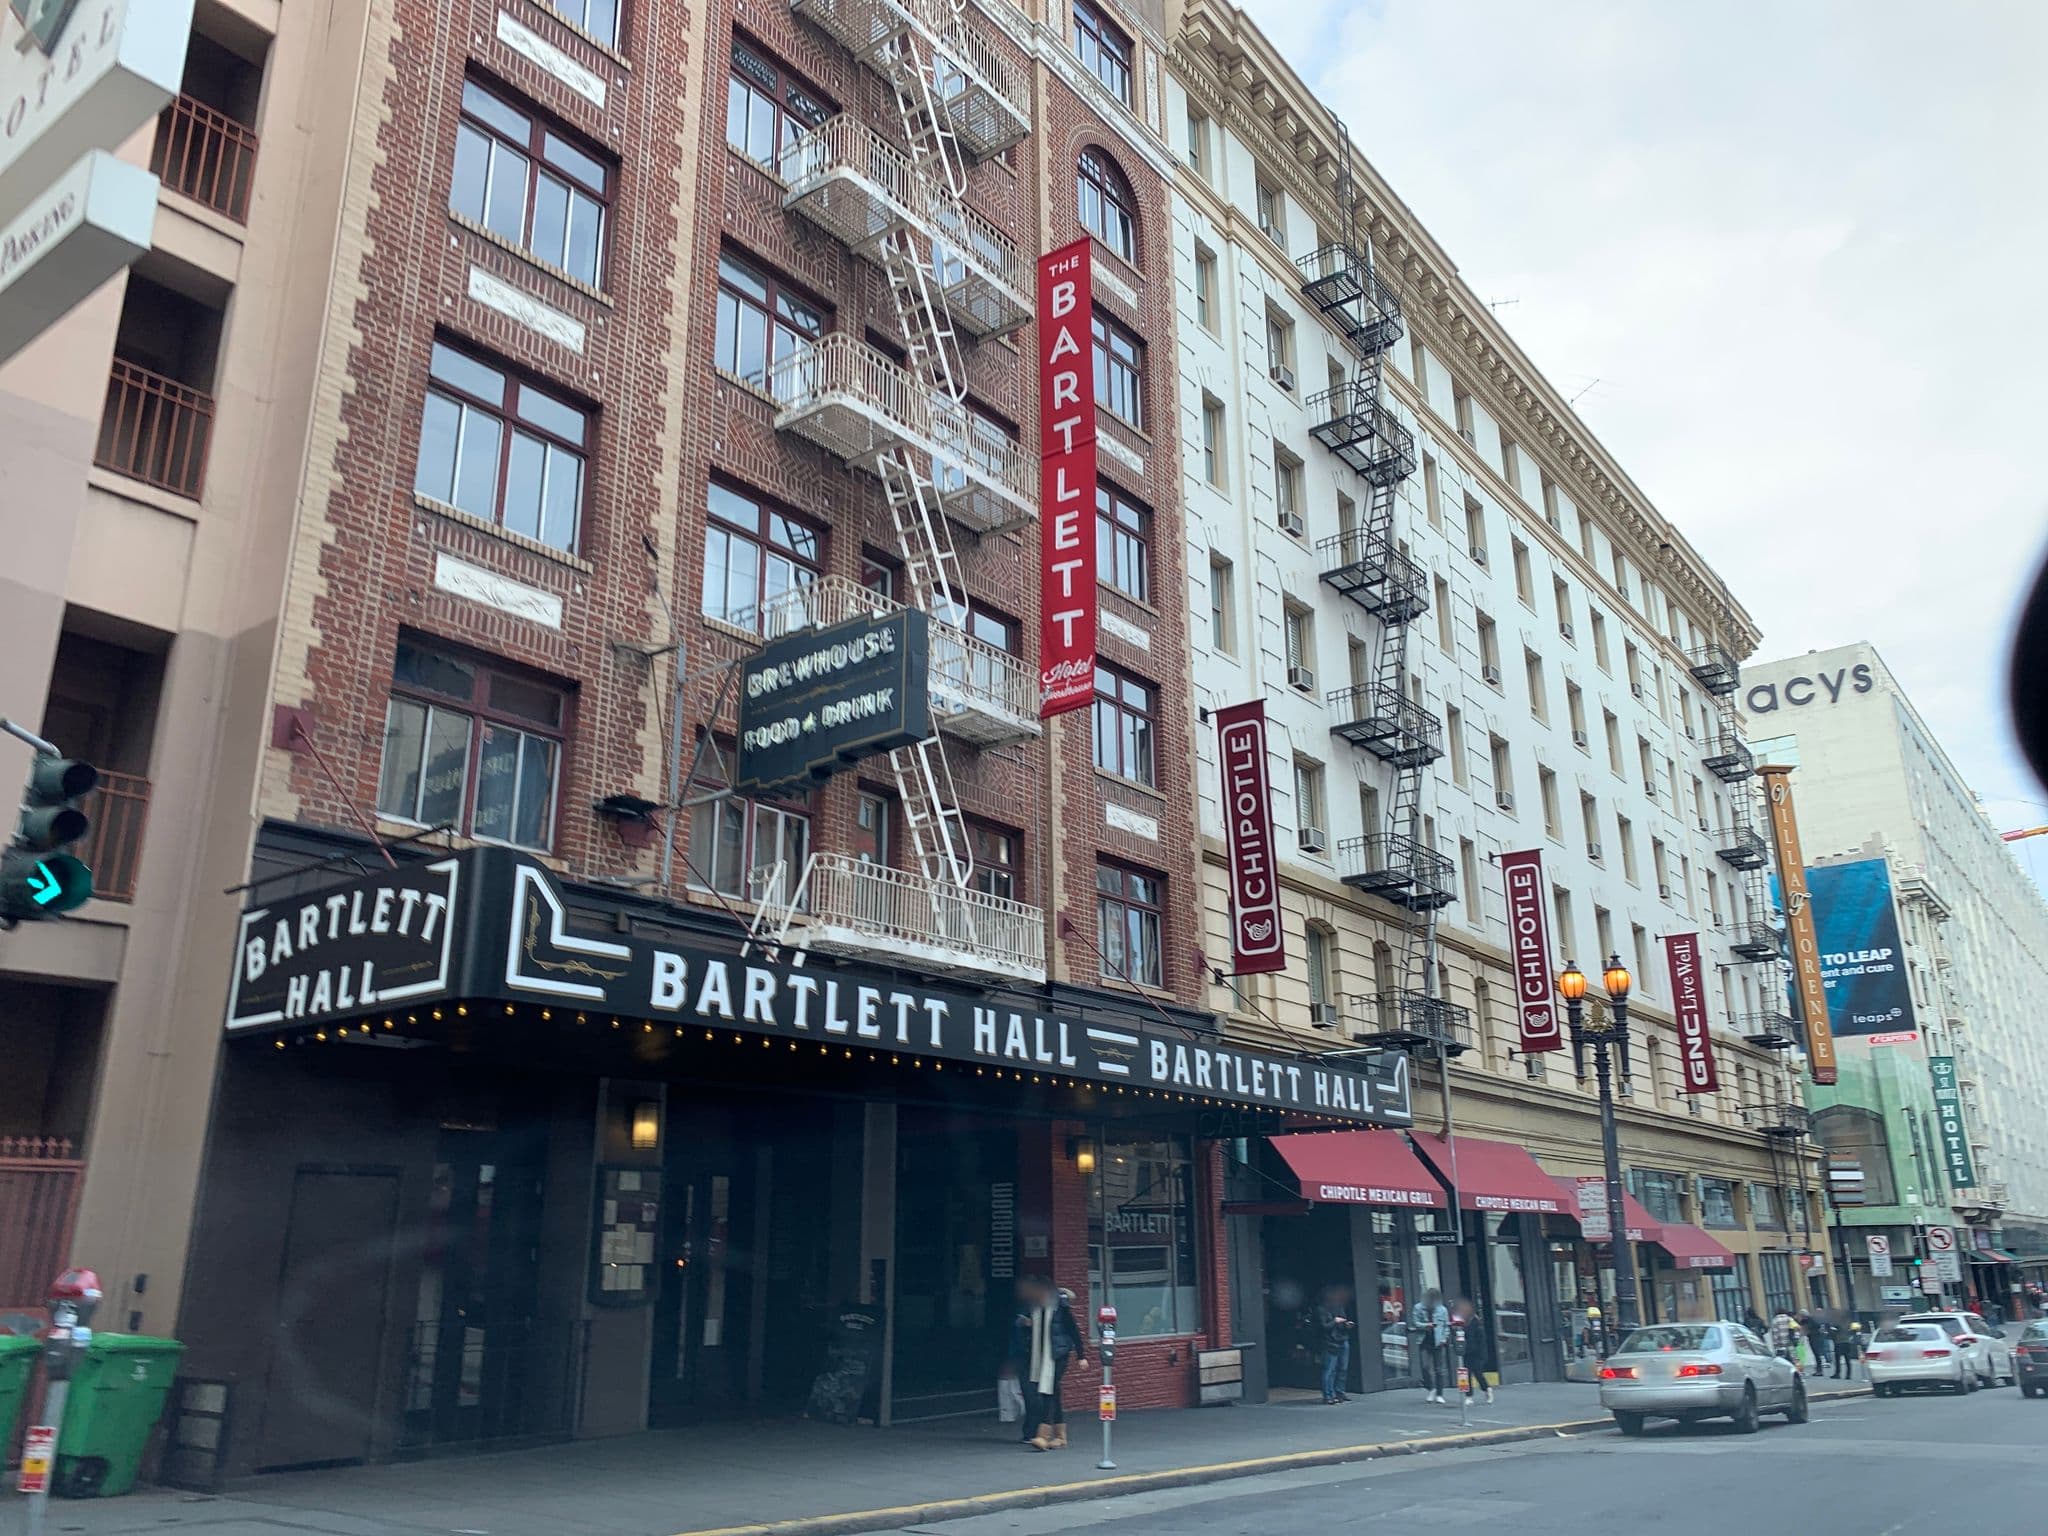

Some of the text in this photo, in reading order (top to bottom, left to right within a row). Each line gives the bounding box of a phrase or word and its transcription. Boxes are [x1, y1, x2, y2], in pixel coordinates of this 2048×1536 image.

[3, 5, 114, 137] OTEL
[1049, 255, 1079, 278] THE
[1049, 280, 1084, 648] BARTLETT
[747, 627, 896, 698] BREWHOUSE
[1042, 654, 1093, 684] Hotel
[1747, 664, 1873, 714] acys
[743, 717, 801, 752] FOOD
[821, 687, 894, 729] DRINK
[1231, 733, 1266, 899] CHIPOTLE
[245, 887, 447, 983] BARTLETT
[1514, 873, 1543, 997] CHIPOTLE
[1771, 783, 1829, 1058] VILLA FLORENCE
[285, 960, 378, 1019] HALL
[1820, 963, 1894, 977] ent and cure
[1822, 948, 1893, 966] TO LEAP
[1823, 980, 1837, 989] er
[649, 950, 1076, 1067] BARTLETT HALL
[1852, 1012, 1893, 1024] leaps
[1150, 1040, 1375, 1113] BARTLETT HALL
[1684, 1014, 1709, 1086] GNC
[1941, 1105, 1968, 1182] HOTEL
[1104, 1211, 1171, 1234] BARTLETT
[1320, 1185, 1434, 1206] CHIPOTLE MEXICAN GRILL
